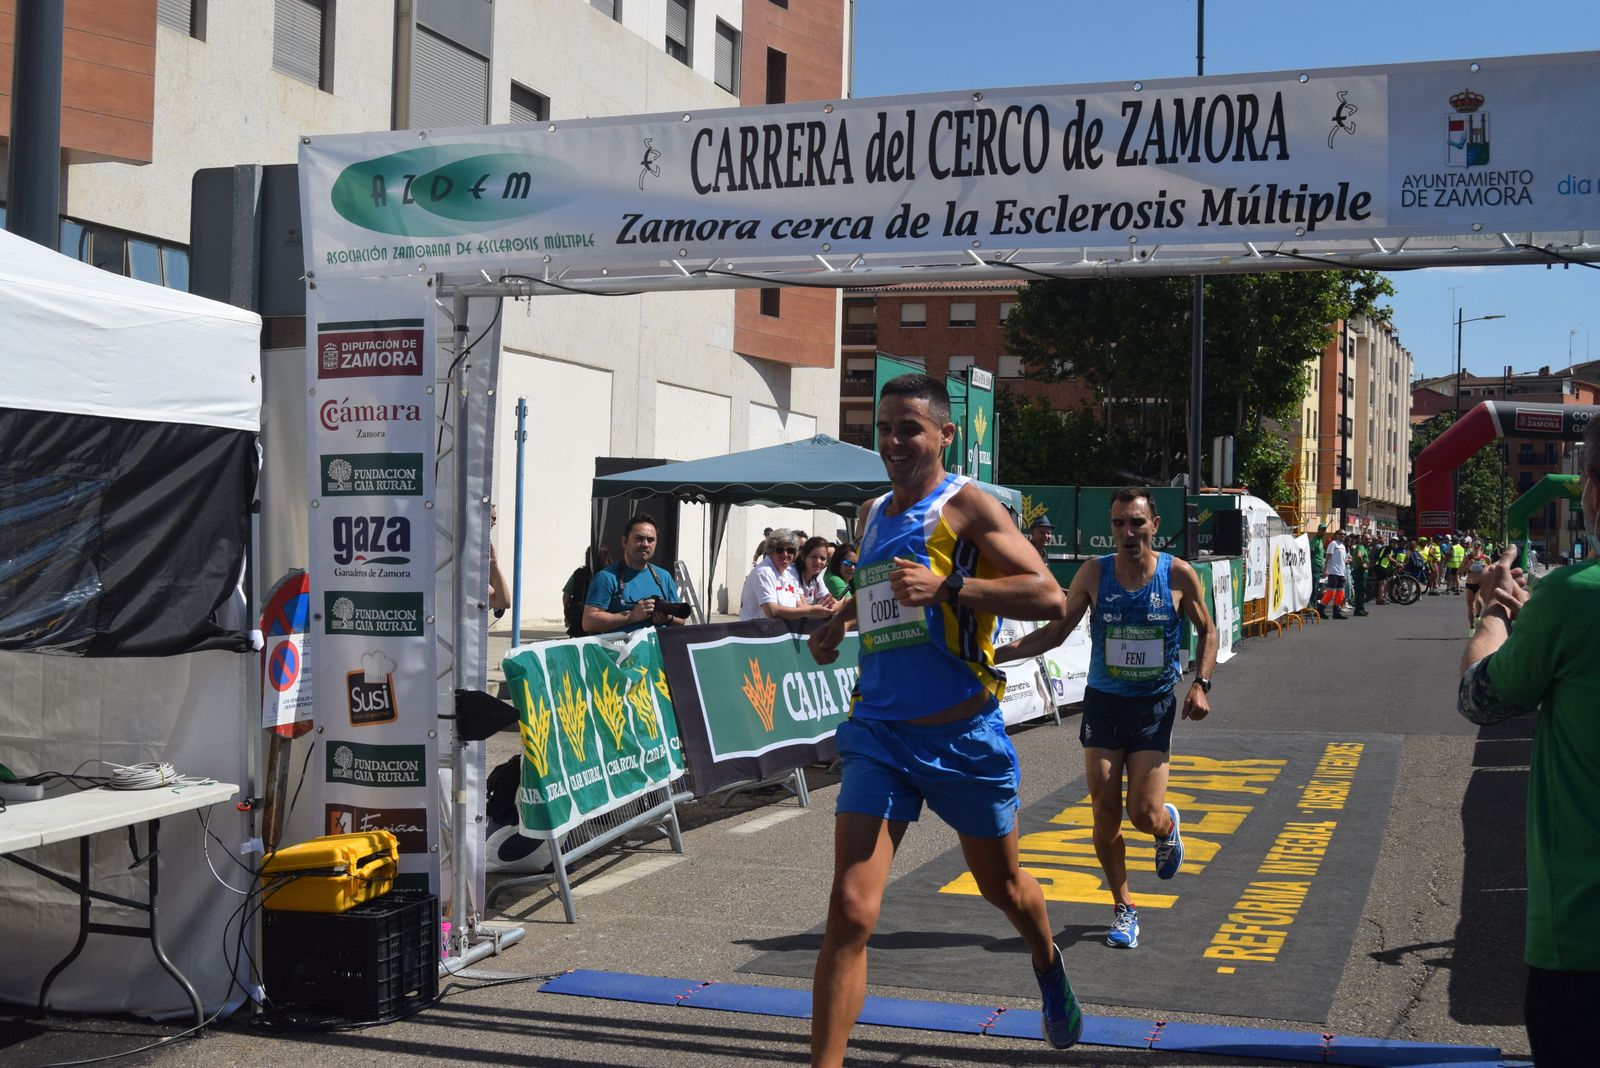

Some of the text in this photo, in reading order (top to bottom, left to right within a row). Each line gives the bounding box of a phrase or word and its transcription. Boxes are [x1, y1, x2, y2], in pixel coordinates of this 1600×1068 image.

[690, 90, 1290, 196] CARRERA del CERCO de ZAMORA
[1401, 169, 1533, 189] AYUNTAMIENTO
[1401, 187, 1533, 208] DE ZAMORA
[615, 181, 1373, 245] Zamora cerca de la Esclerosis Múltiple
[326, 232, 595, 265] ASOCIACIÓN ZAMORANA DE ESCLEROSIS MÚLTIPLE
[341, 338, 417, 352] DIPUTACIÓN DE
[340, 351, 418, 369] ZAMORA
[1527, 420, 1560, 429] ZAMORA
[356, 428, 385, 439] Zamora
[354, 468, 416, 480] FUNDACION
[354, 480, 416, 491] CAJA RURAL
[332, 515, 411, 566] gaza
[1089, 535, 1116, 549] CAJ
[334, 567, 411, 578] Ganaderos de Zamora
[355, 608, 417, 621] FUNDACION
[871, 598, 900, 624] CODE
[355, 620, 417, 632] CAJA RURAL
[873, 628, 922, 645] CAJA RURAL
[1125, 651, 1146, 666] FENI
[351, 684, 390, 713] Susi
[782, 669, 839, 722] CAJA
[354, 758, 419, 771] FUNDACION
[354, 770, 419, 782] CAJA RURAL
[1295, 780, 1352, 810] DISEÑO
[1202, 820, 1338, 962] REFORMA INTEGRAL
